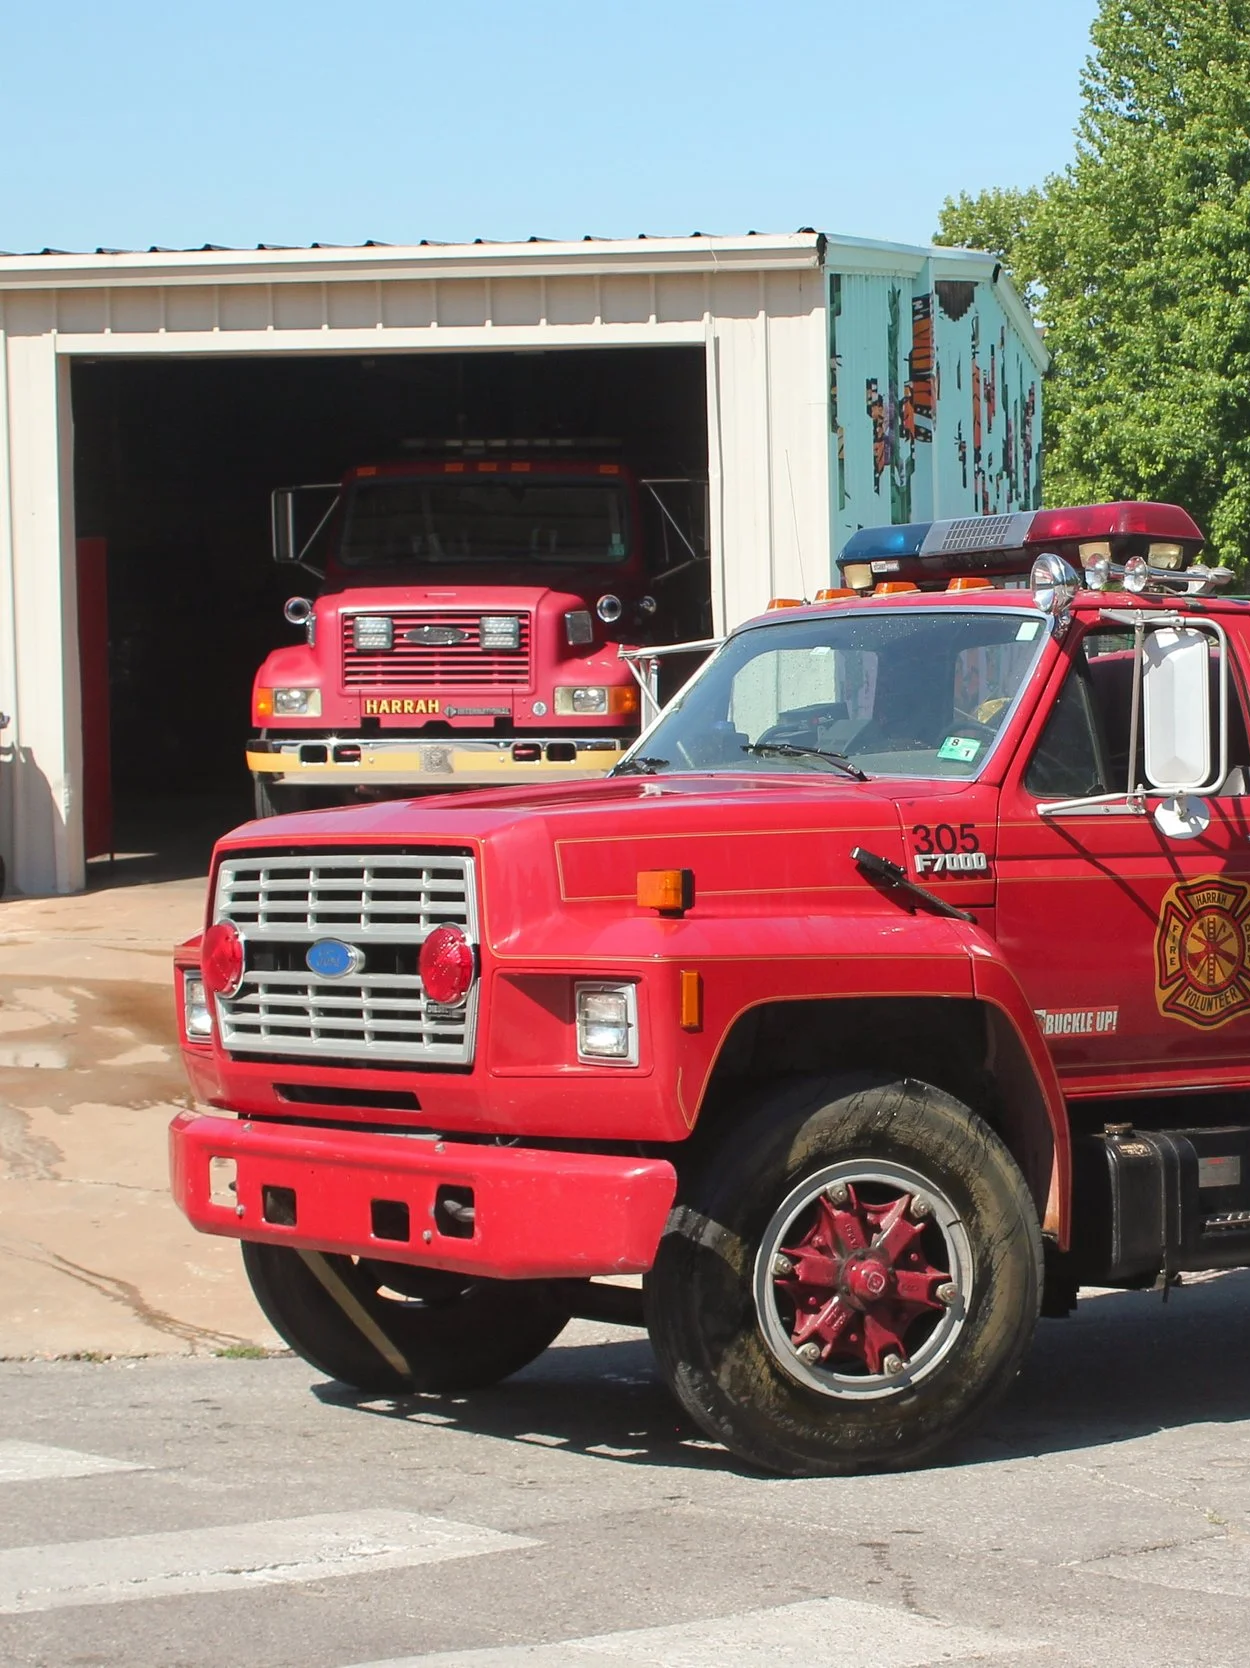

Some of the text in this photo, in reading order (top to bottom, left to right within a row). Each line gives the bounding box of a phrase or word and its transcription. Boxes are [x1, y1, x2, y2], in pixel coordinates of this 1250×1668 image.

[365, 699, 440, 713] HARRAH
[951, 738, 960, 747] 8
[912, 824, 979, 854] 305
[914, 853, 987, 873] F7000
[1196, 892, 1227, 905] HARRAH
[1169, 924, 1179, 966] FIRE
[1184, 986, 1238, 1012] VOLUNTEER
[1045, 1011, 1118, 1034] BUCKLE UP!
